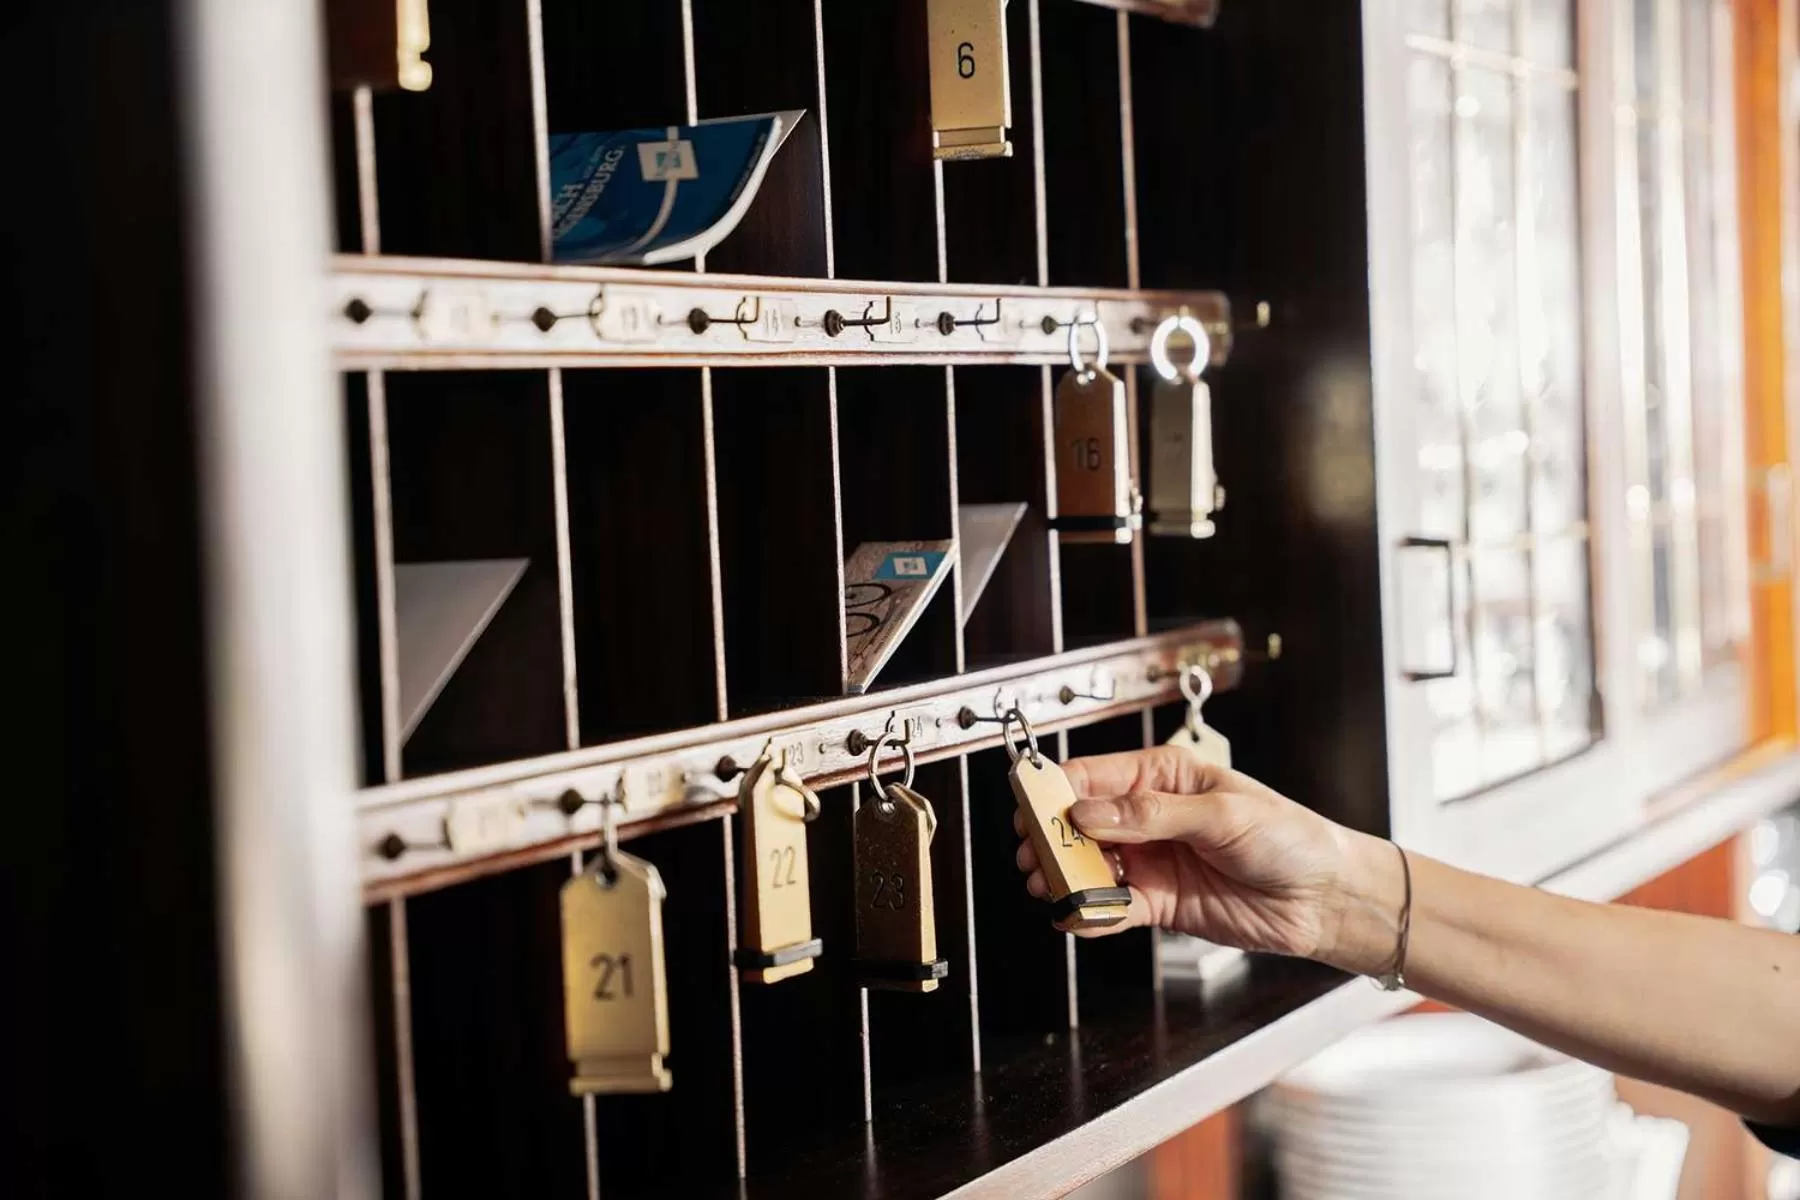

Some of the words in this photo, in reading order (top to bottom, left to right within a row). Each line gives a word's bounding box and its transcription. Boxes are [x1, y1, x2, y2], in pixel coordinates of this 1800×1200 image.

[957, 41, 975, 79] 6
[1071, 437, 1101, 471] 16
[769, 845, 797, 889] 22
[870, 869, 905, 911] 23
[590, 952, 634, 1001] 21
